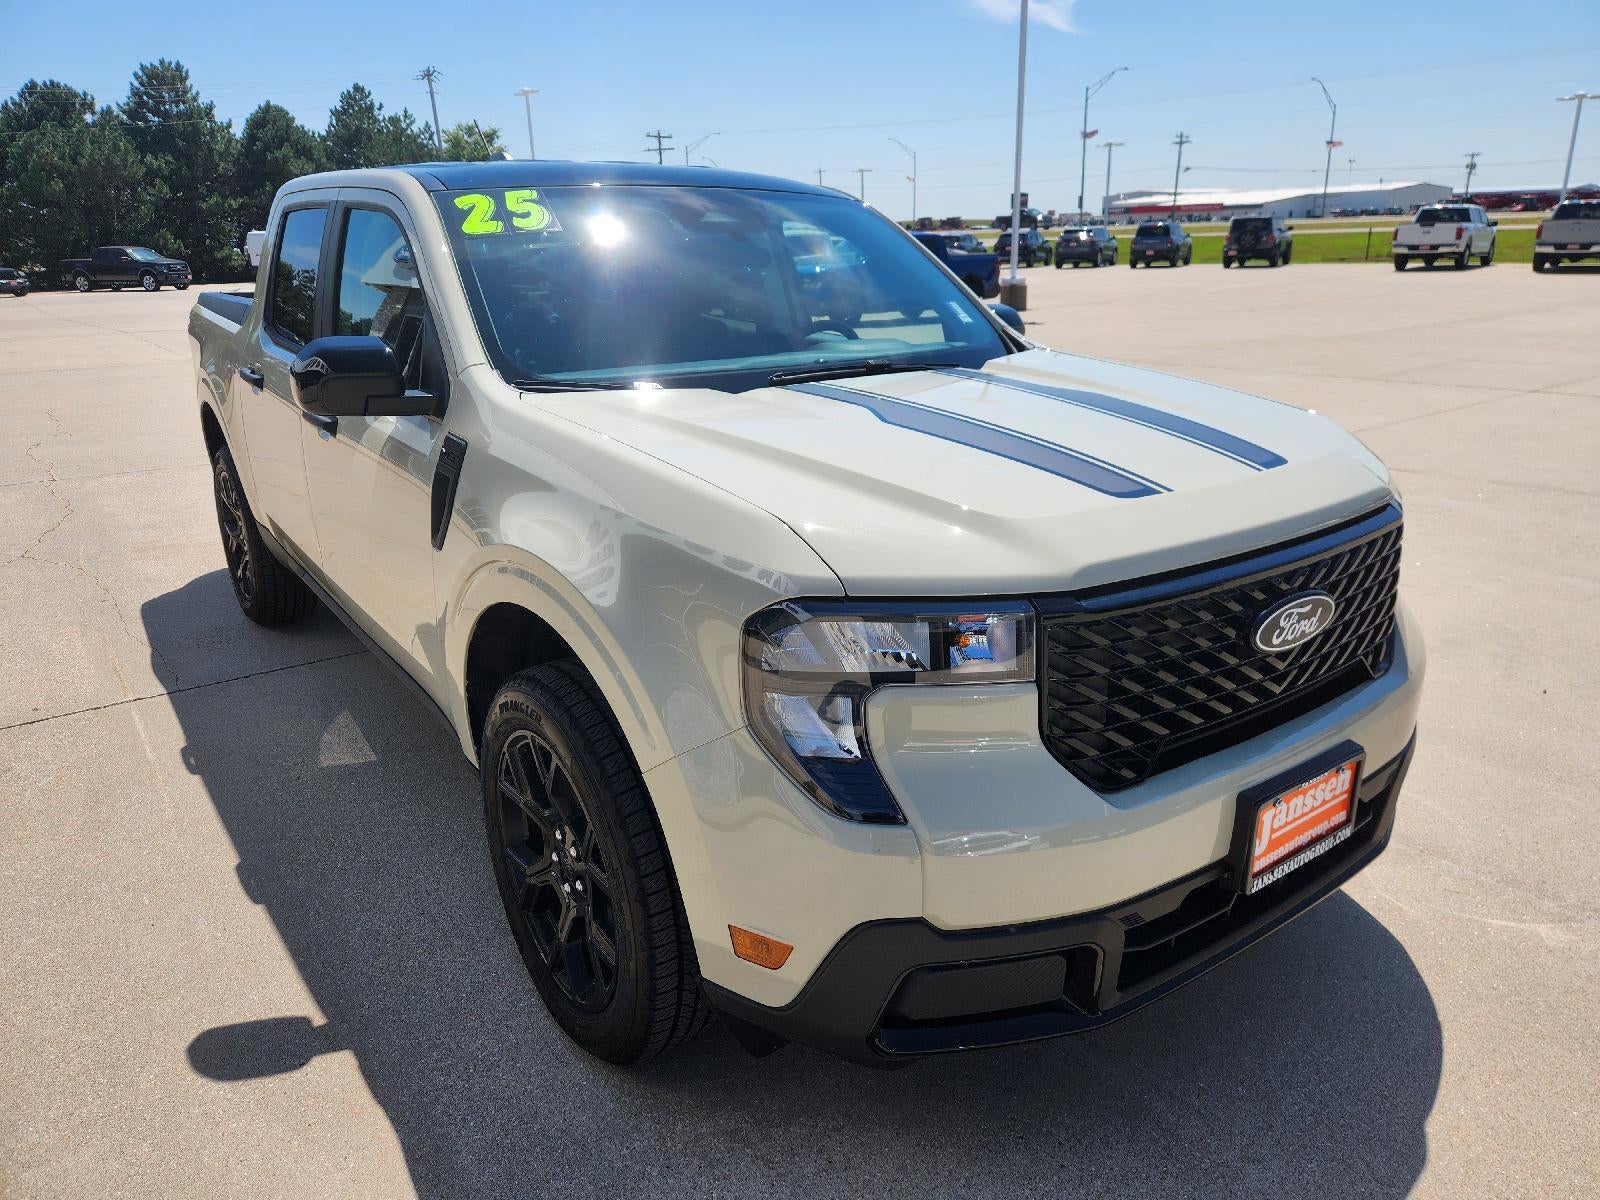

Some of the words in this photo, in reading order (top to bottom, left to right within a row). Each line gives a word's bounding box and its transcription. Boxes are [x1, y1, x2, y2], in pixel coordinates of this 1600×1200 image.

[453, 190, 552, 235] 25
[1271, 603, 1323, 646] Ford
[1254, 769, 1352, 857] Janssen
